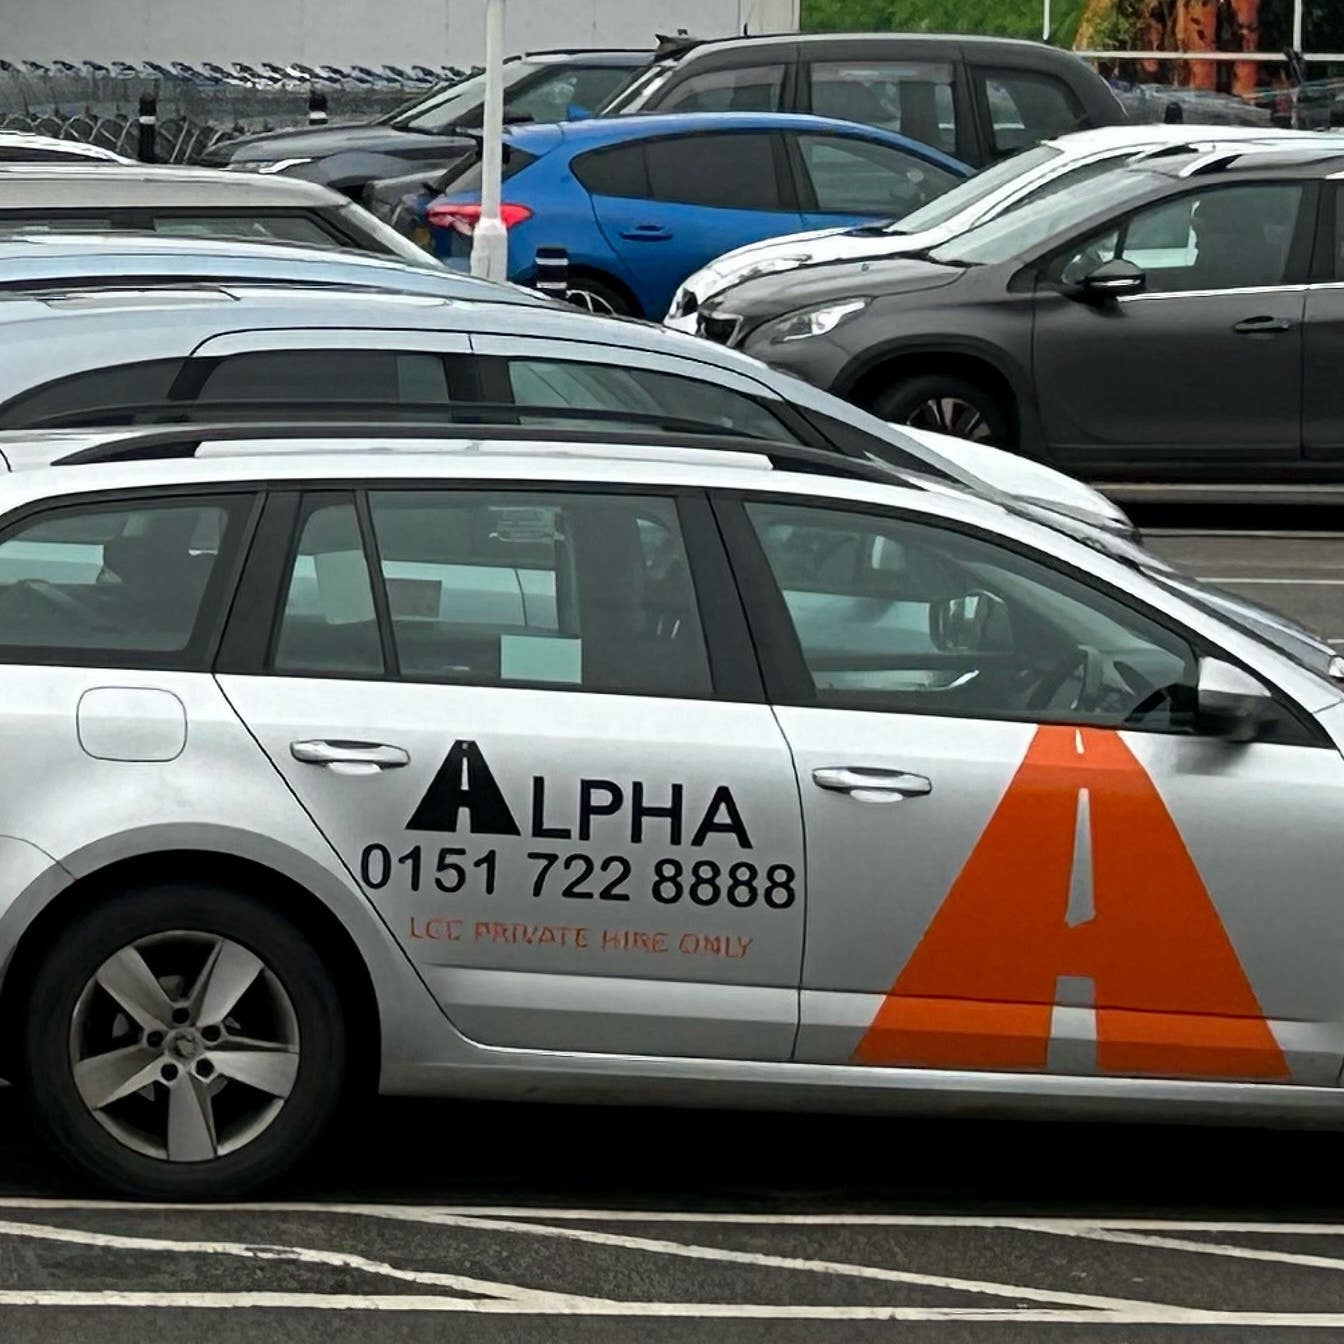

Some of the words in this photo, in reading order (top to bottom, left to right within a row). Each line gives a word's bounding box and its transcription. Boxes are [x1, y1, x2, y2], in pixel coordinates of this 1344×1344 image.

[404, 739, 754, 850] ALPHA
[360, 842, 497, 896] 0151
[526, 852, 632, 903] 722
[651, 858, 797, 910] 8888
[474, 920, 590, 949] PRIVATE
[601, 929, 668, 954] HIRE
[678, 933, 754, 959] ONLY
